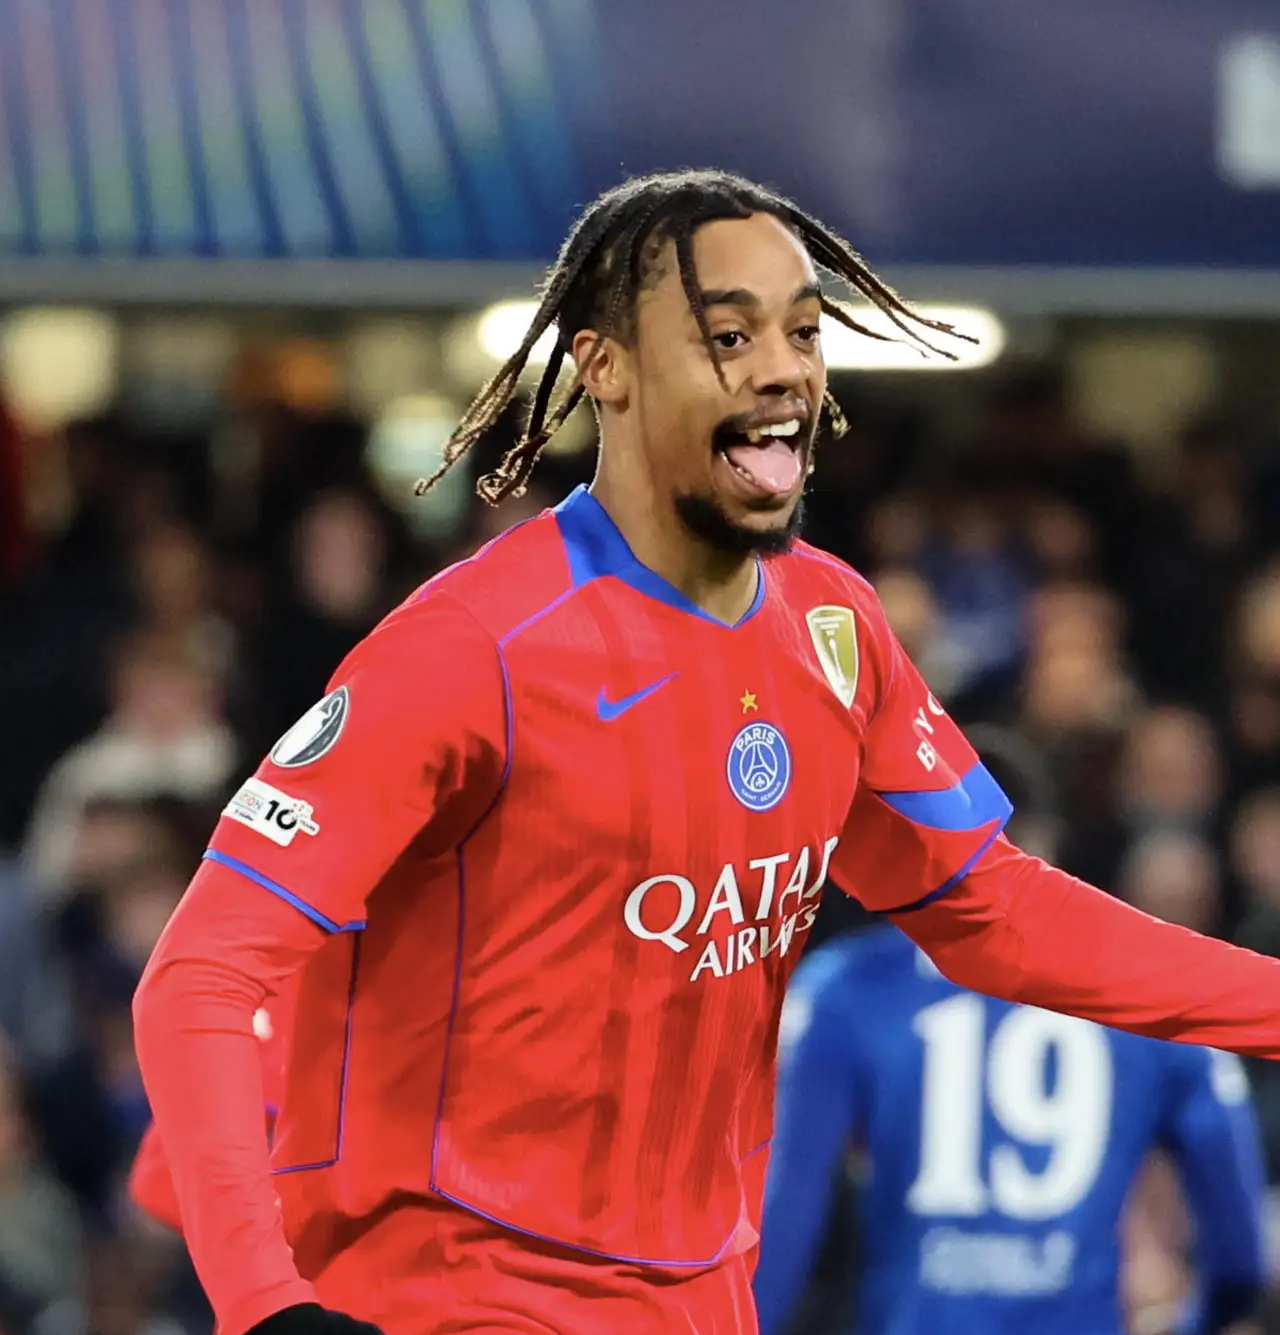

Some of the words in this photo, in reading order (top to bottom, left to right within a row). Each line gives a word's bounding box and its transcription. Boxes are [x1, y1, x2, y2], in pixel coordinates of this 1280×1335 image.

[735, 727, 776, 752] PARIS
[264, 800, 297, 830] 10
[907, 992, 1114, 1221] 19
